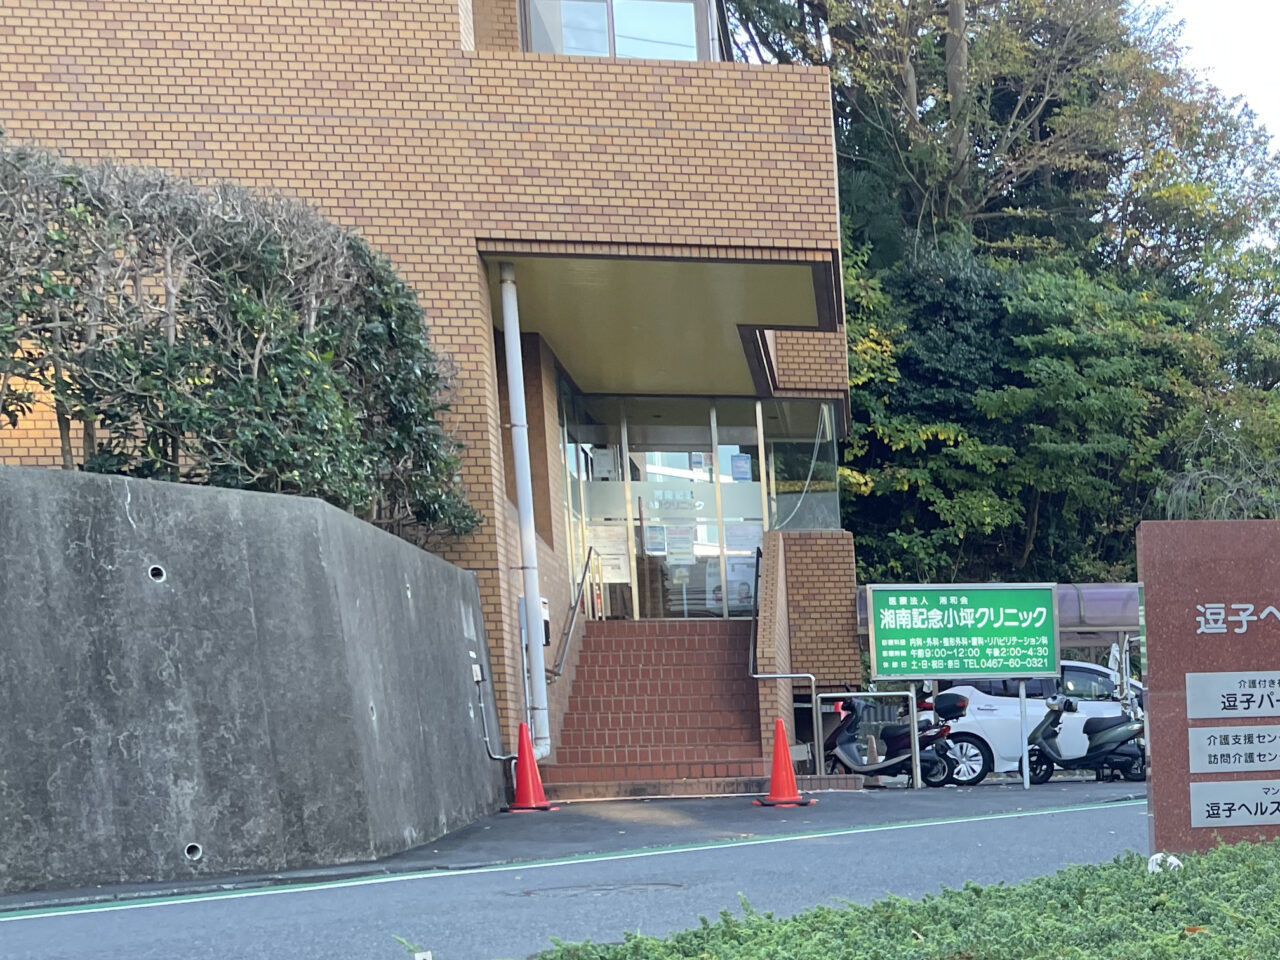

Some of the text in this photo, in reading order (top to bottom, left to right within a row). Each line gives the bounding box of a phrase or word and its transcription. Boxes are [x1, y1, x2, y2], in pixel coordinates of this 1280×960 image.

[888, 597, 929, 605] 医療法人
[880, 607, 1047, 629] 湘南記念小坪クリニック
